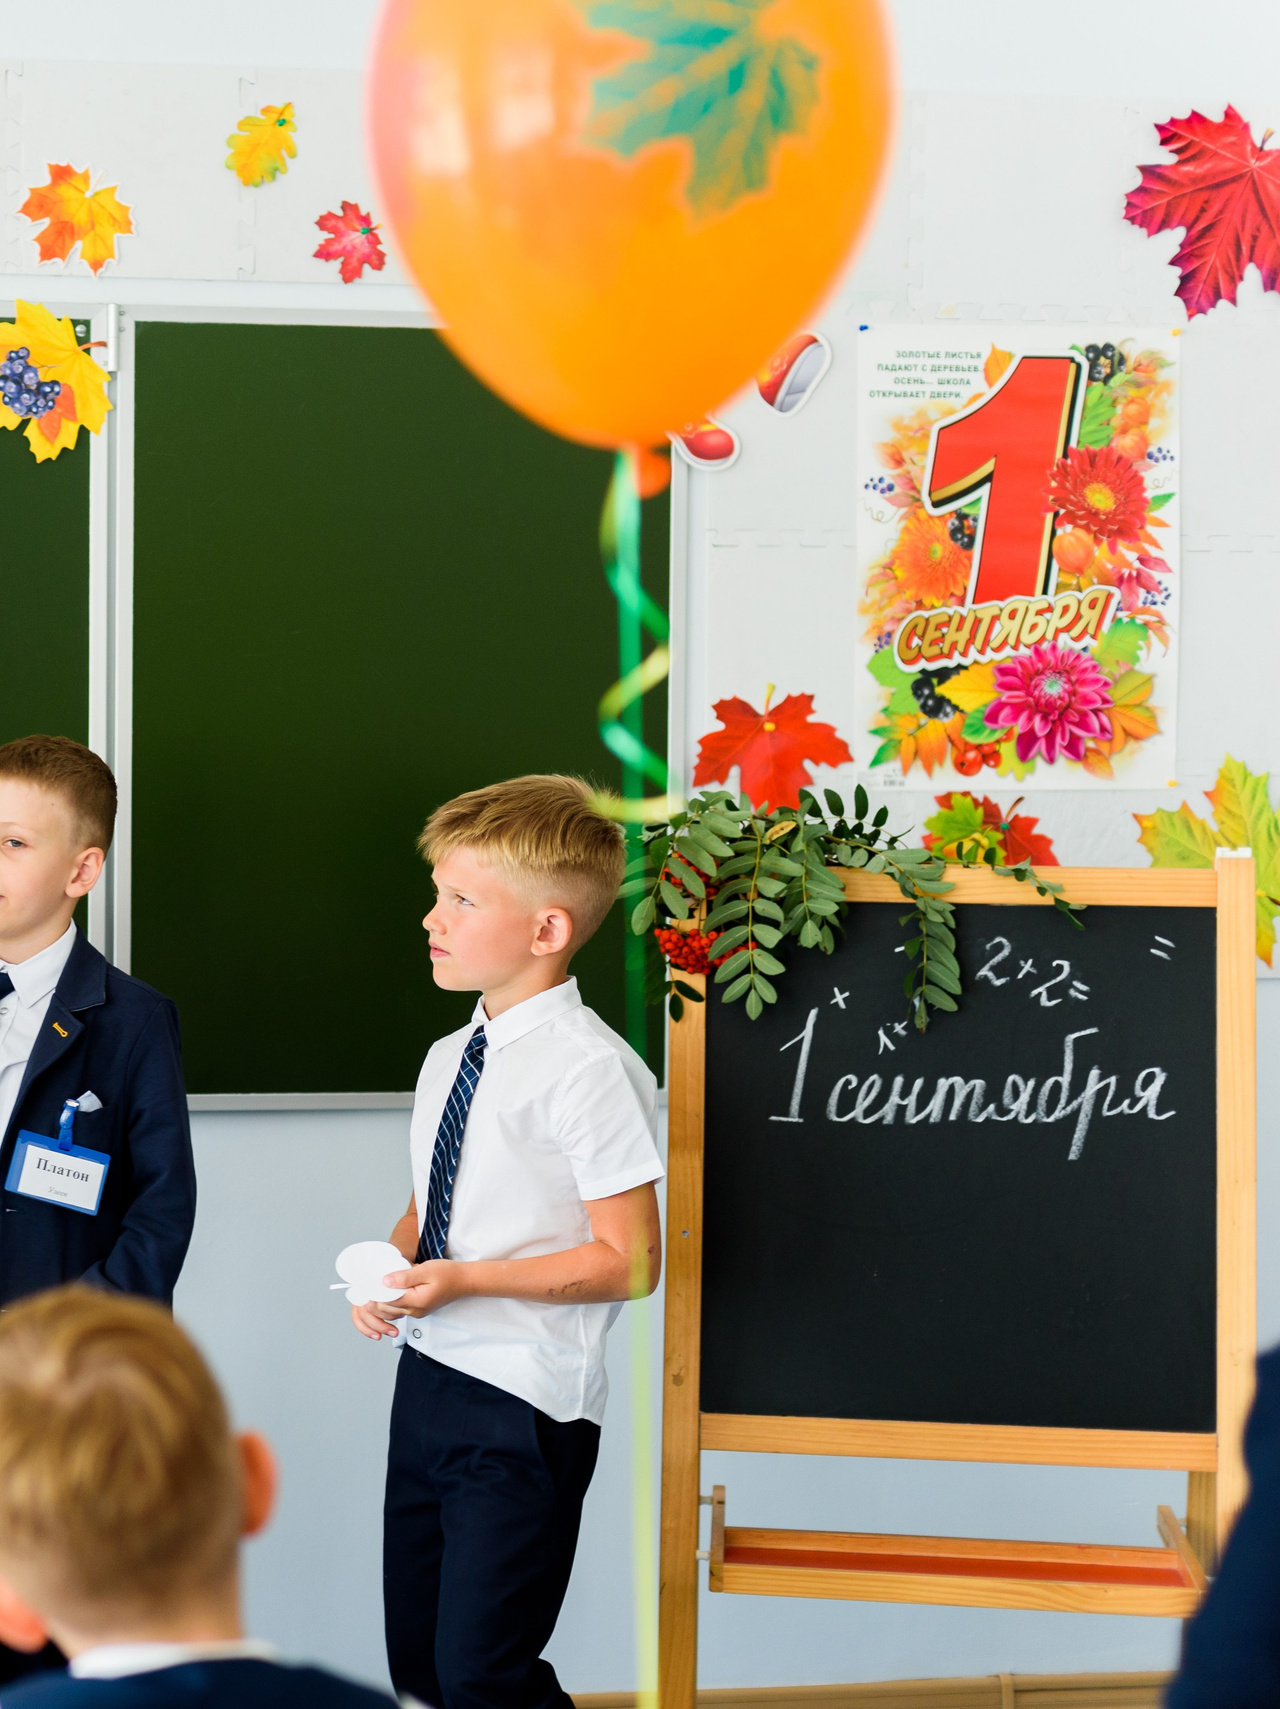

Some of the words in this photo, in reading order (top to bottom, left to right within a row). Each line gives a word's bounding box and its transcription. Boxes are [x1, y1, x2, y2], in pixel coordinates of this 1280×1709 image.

[895, 350, 942, 359] ЗОЛОТЫЕ
[944, 351, 982, 359] ЛИСТЬЯ
[877, 363, 919, 372] ПАДАЮТ
[921, 364, 928, 372] С
[937, 378, 972, 386] ШКОЛА
[869, 390, 927, 398] ОТКРЫВАЕТ
[927, 354, 1083, 608] 1
[897, 588, 1114, 665] СЕНТЯБРЯ
[769, 1007, 818, 1123] 1
[826, 1027, 1176, 1161] сентября
[36, 1157, 90, 1183] Платон
